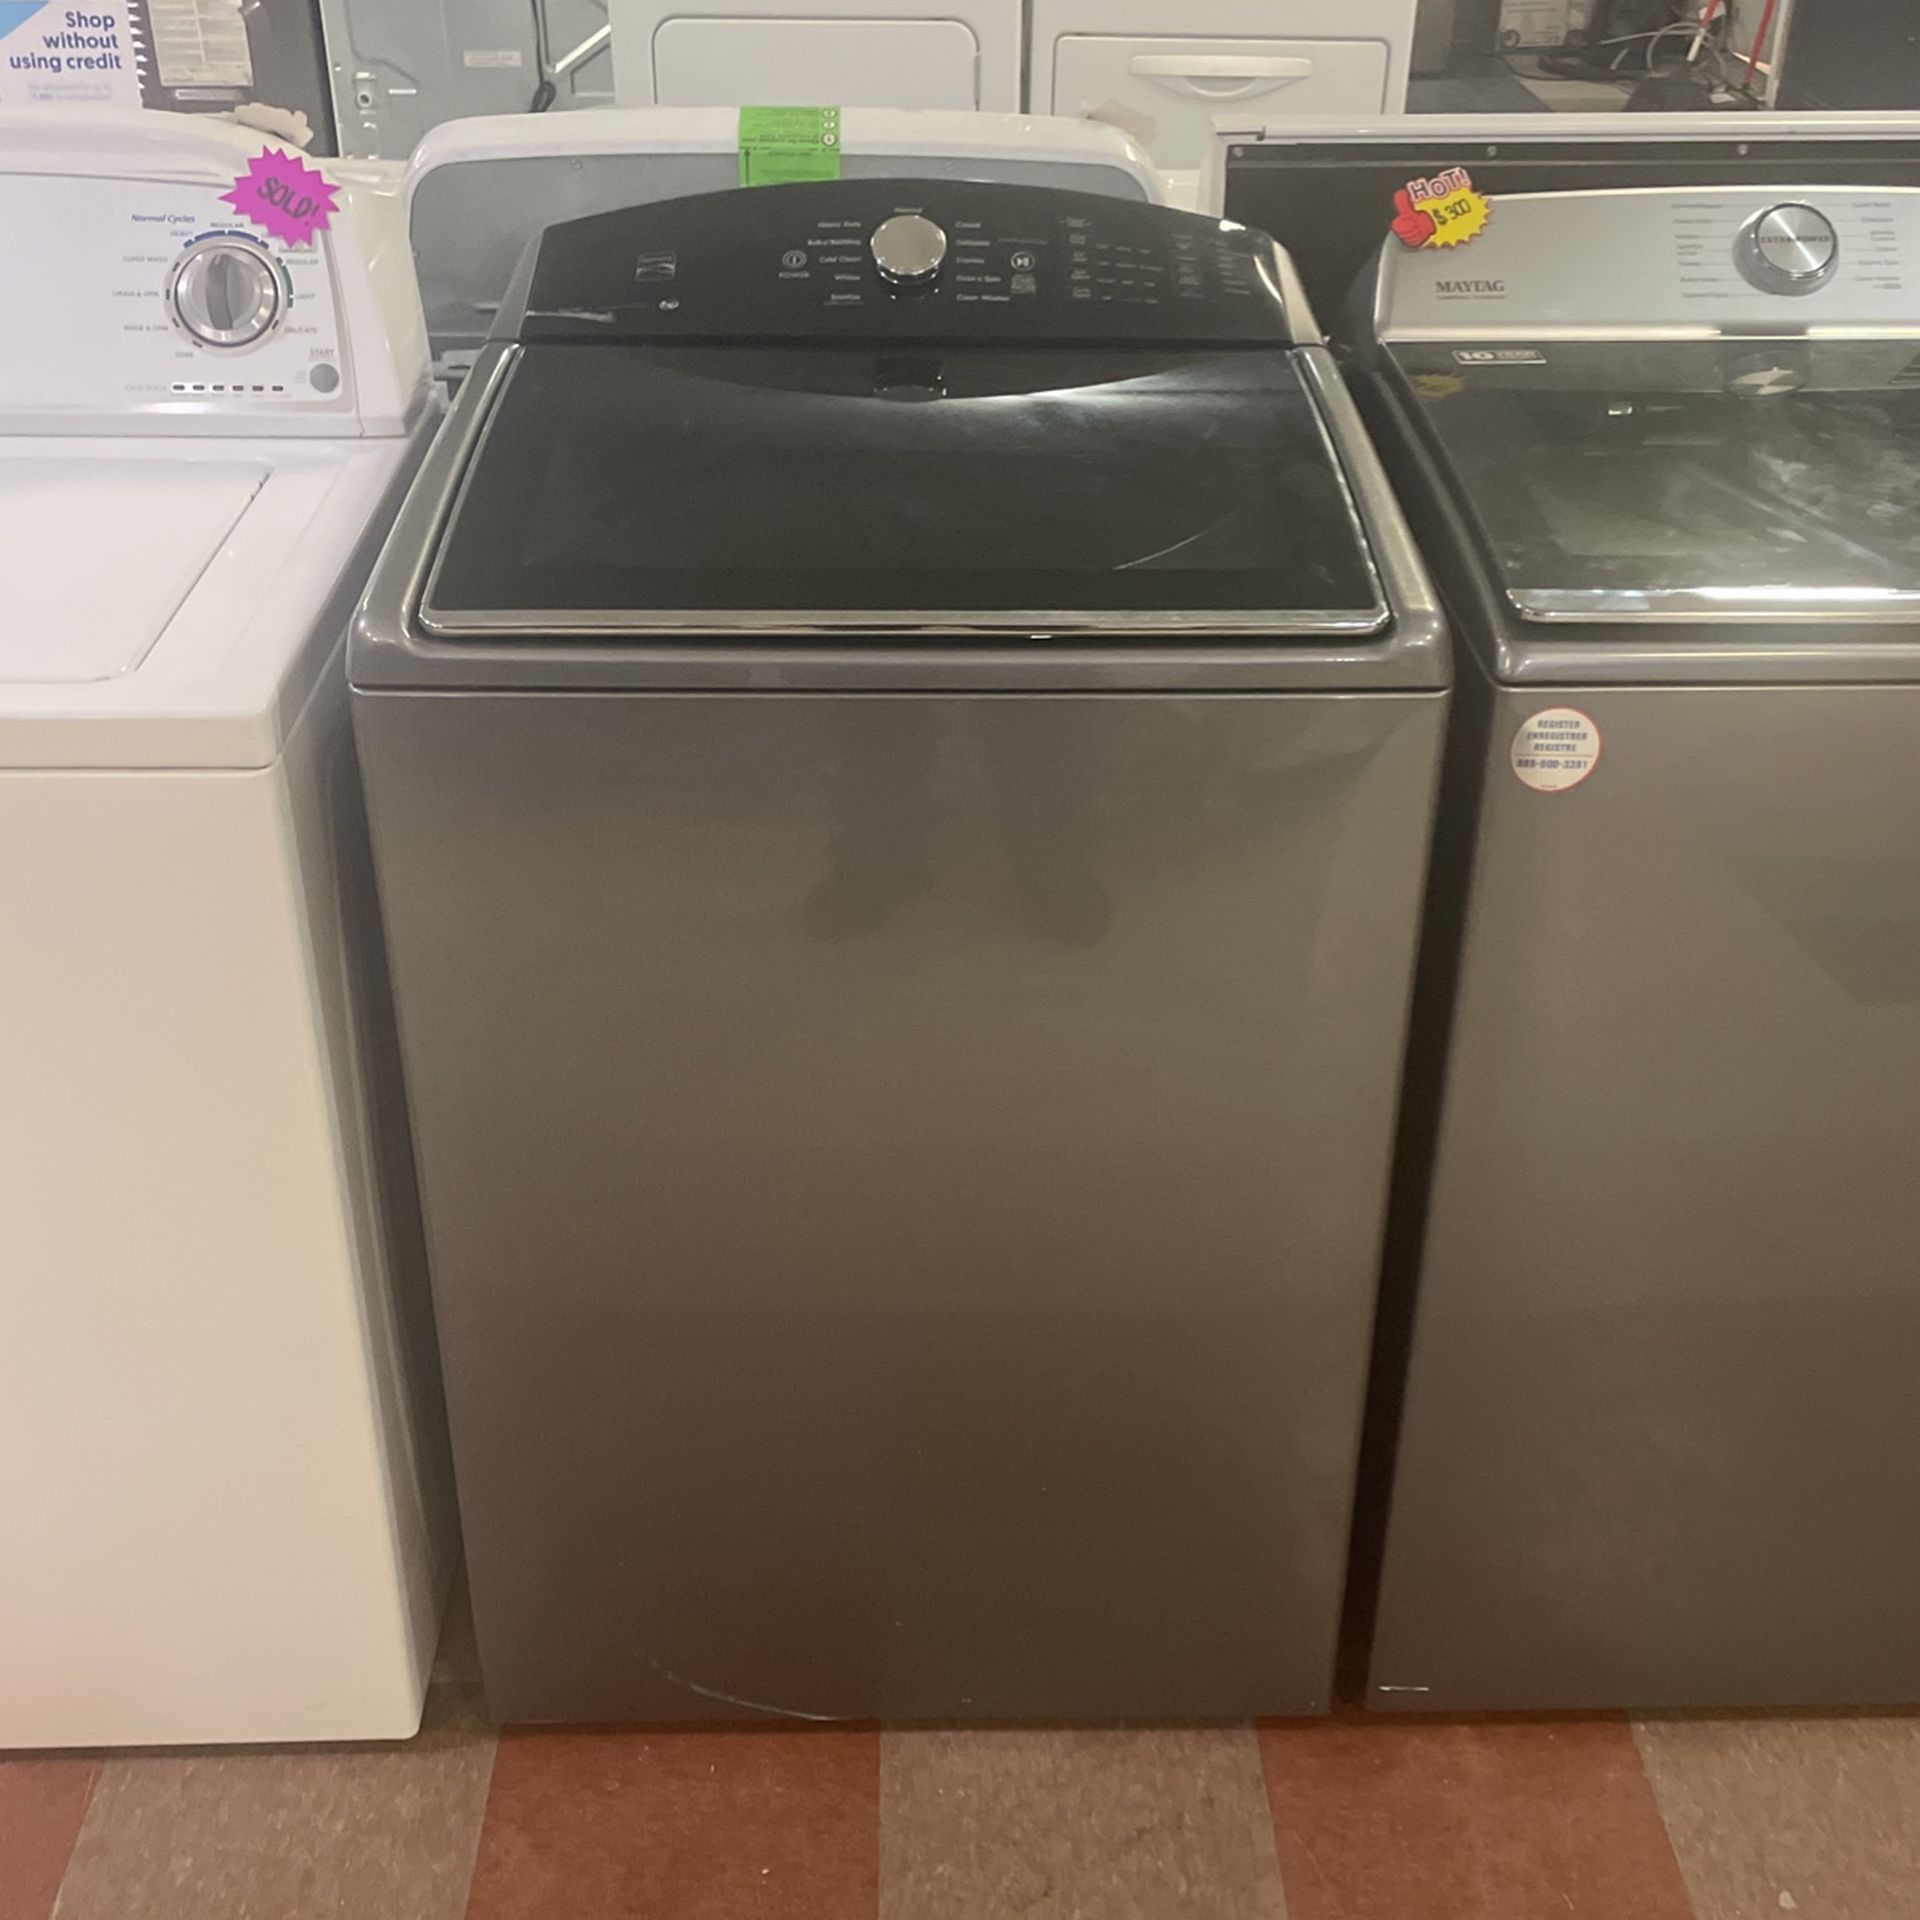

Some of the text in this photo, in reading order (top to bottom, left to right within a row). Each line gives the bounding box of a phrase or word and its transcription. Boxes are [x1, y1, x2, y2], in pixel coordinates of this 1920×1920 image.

[65, 10, 116, 32] Shop
[42, 31, 119, 49] without
[9, 52, 122, 73] using credit
[1408, 168, 1470, 201] HOT!
[256, 176, 321, 226] SOLD!
[131, 214, 196, 224] Normal Cycles
[1435, 279, 1505, 293] MAYTAG
[309, 348, 335, 357] START
[1458, 351, 1495, 360] 10
[1537, 720, 1580, 729] REGISTER
[1526, 731, 1588, 740] ENREGISTRER
